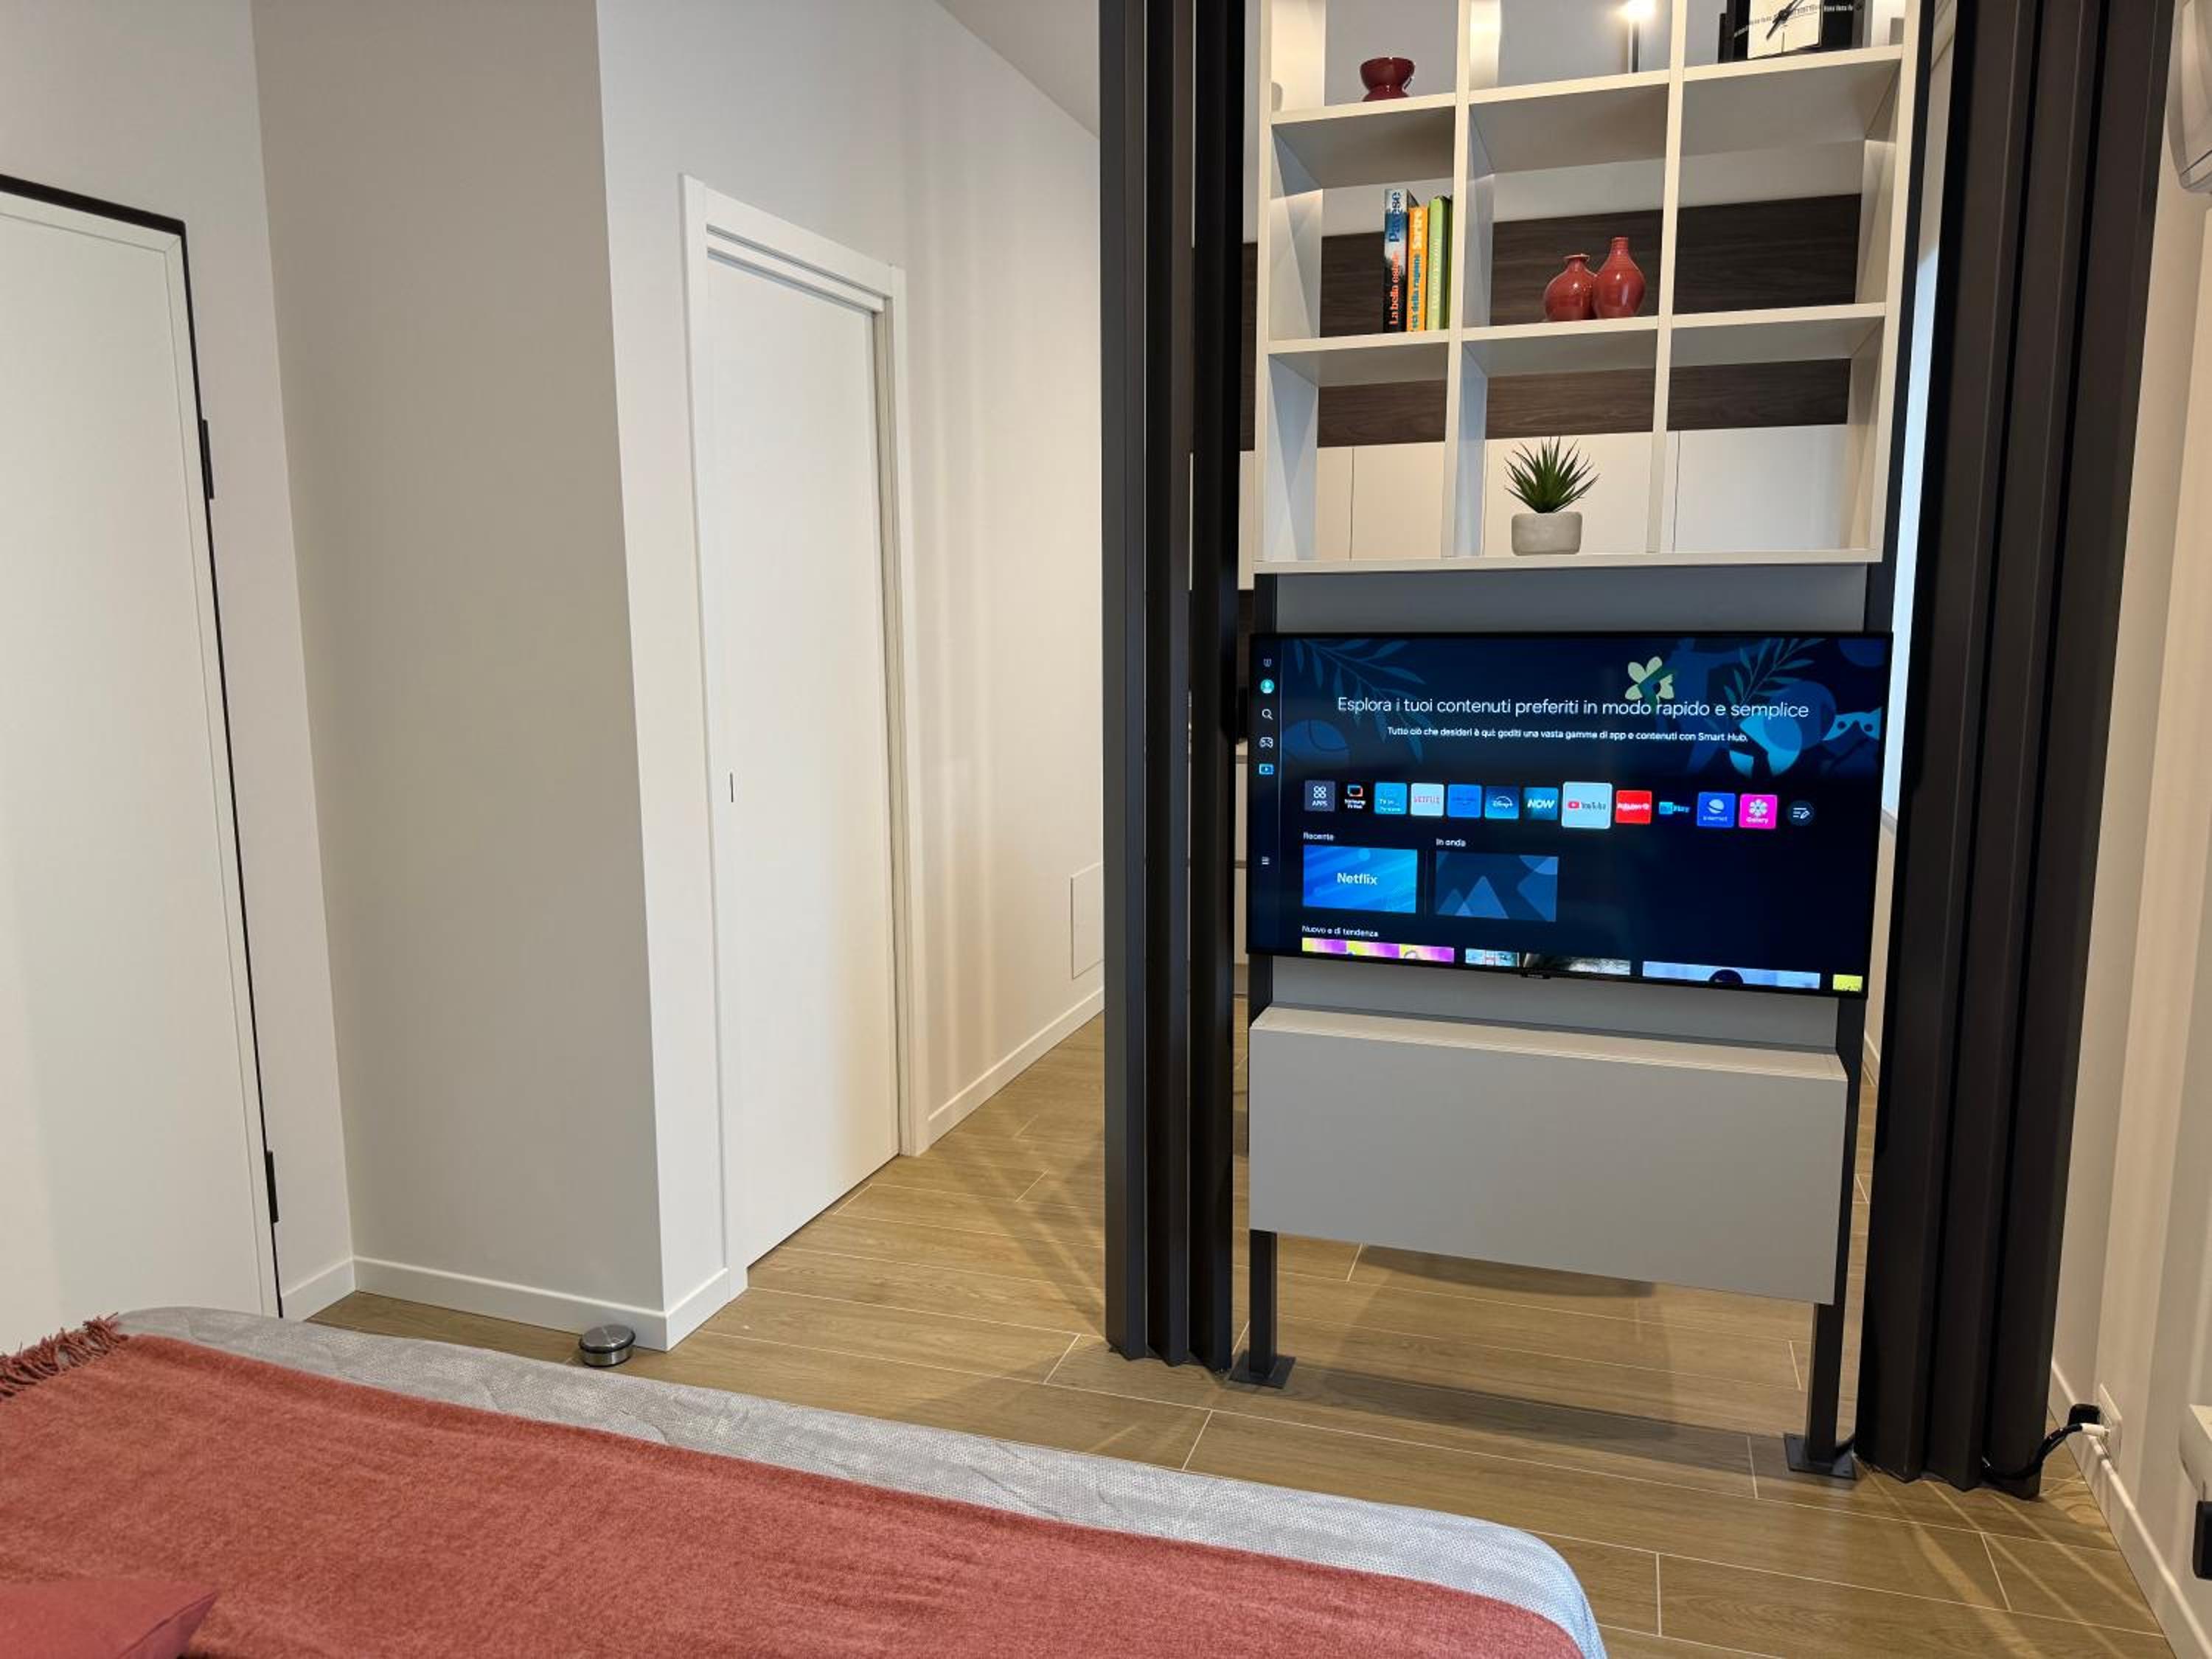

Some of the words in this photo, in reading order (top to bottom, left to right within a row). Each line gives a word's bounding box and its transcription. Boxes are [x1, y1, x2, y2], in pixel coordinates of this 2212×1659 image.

[1338, 696, 1391, 714] Esplora
[1396, 698, 1401, 712] i
[1403, 698, 1433, 713] tuoi
[1437, 698, 1512, 714] contenuti
[1515, 698, 1579, 717] preferiti
[1583, 700, 1599, 714] in
[1602, 700, 1652, 715] modo
[1655, 701, 1711, 719] rapido
[1714, 703, 1727, 717] e
[1731, 702, 1809, 721] semplice
[1387, 726, 1409, 736] Tutto
[1424, 728, 1439, 736] che
[1441, 728, 1473, 737] desideri
[1498, 728, 1522, 739] goditi
[1541, 730, 1564, 739] vasta
[1599, 731, 1608, 739] di
[1610, 732, 1627, 740] app
[1635, 731, 1677, 741] contenuti
[1698, 732, 1725, 742] Smart
[1527, 799, 1556, 810] NOW
[1444, 838, 1467, 847] onda
[1336, 872, 1378, 886] Netflix
[1301, 925, 1326, 934] Nuovo
[1333, 927, 1341, 935] di
[1343, 928, 1379, 938] tendenza
